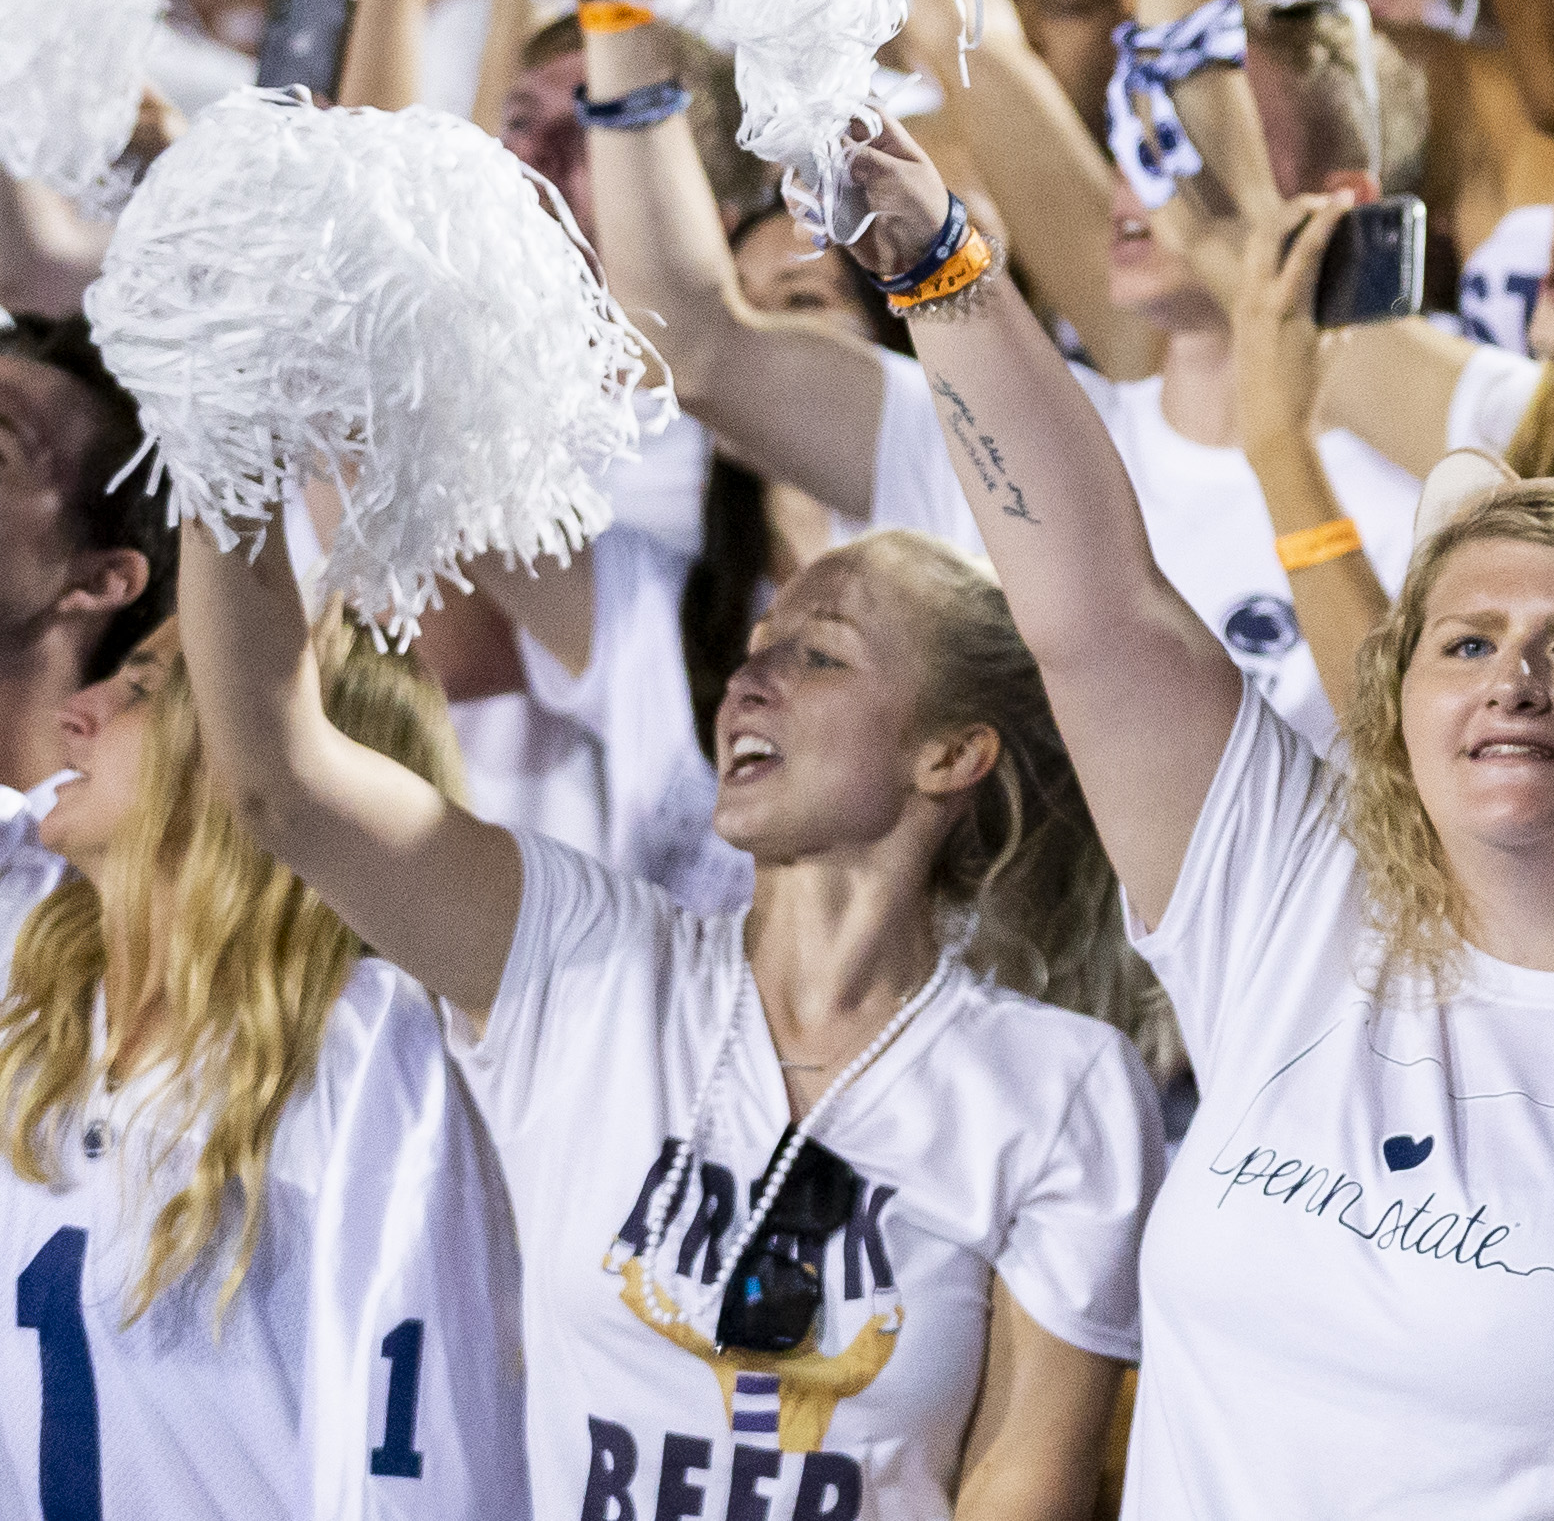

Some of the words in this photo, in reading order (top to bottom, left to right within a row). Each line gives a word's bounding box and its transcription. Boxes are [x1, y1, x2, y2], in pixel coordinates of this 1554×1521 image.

[1216, 1138, 1368, 1236] penn
[1376, 1202, 1512, 1271] state
[15, 1226, 104, 1521] 1
[371, 1318, 424, 1479] 1
